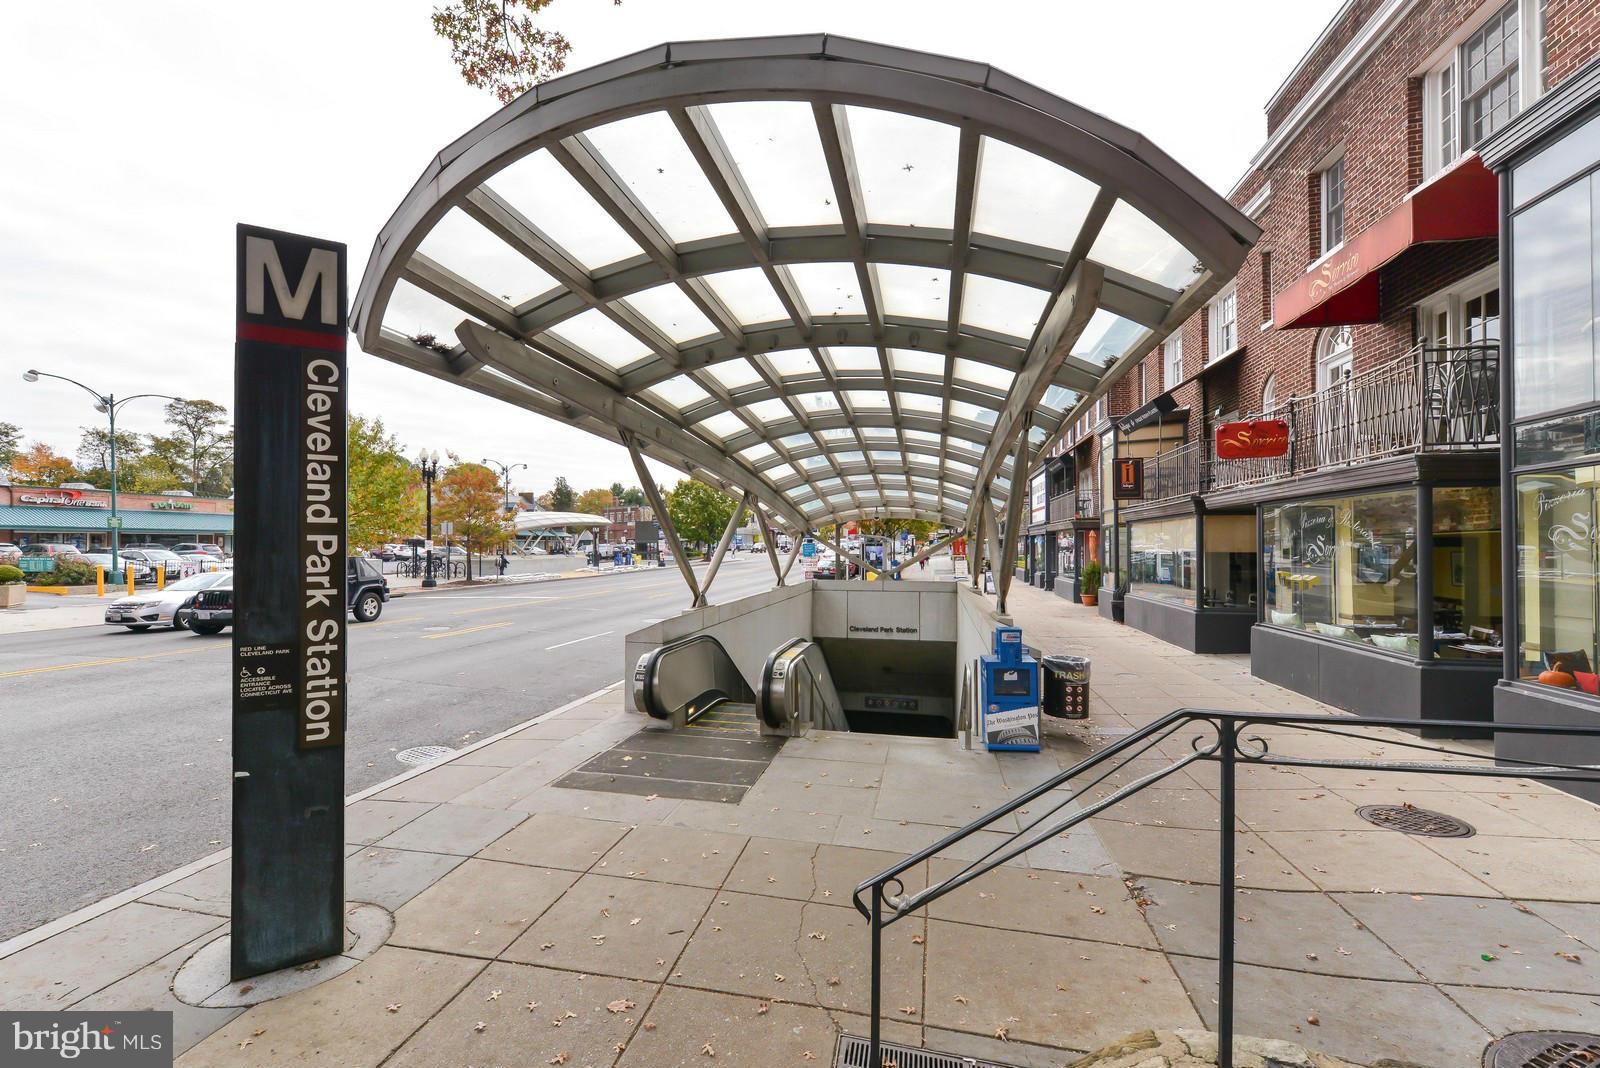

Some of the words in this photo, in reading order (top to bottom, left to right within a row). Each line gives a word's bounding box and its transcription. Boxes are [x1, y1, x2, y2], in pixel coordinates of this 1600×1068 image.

[246, 236, 338, 325] M
[306, 359, 340, 524] Cleveland
[20, 495, 64, 505] Capital
[305, 534, 338, 608] Park
[849, 625, 879, 633] Cleveland
[895, 626, 918, 634] Station
[305, 619, 339, 742] Station
[1055, 671, 1085, 680] TRASH
